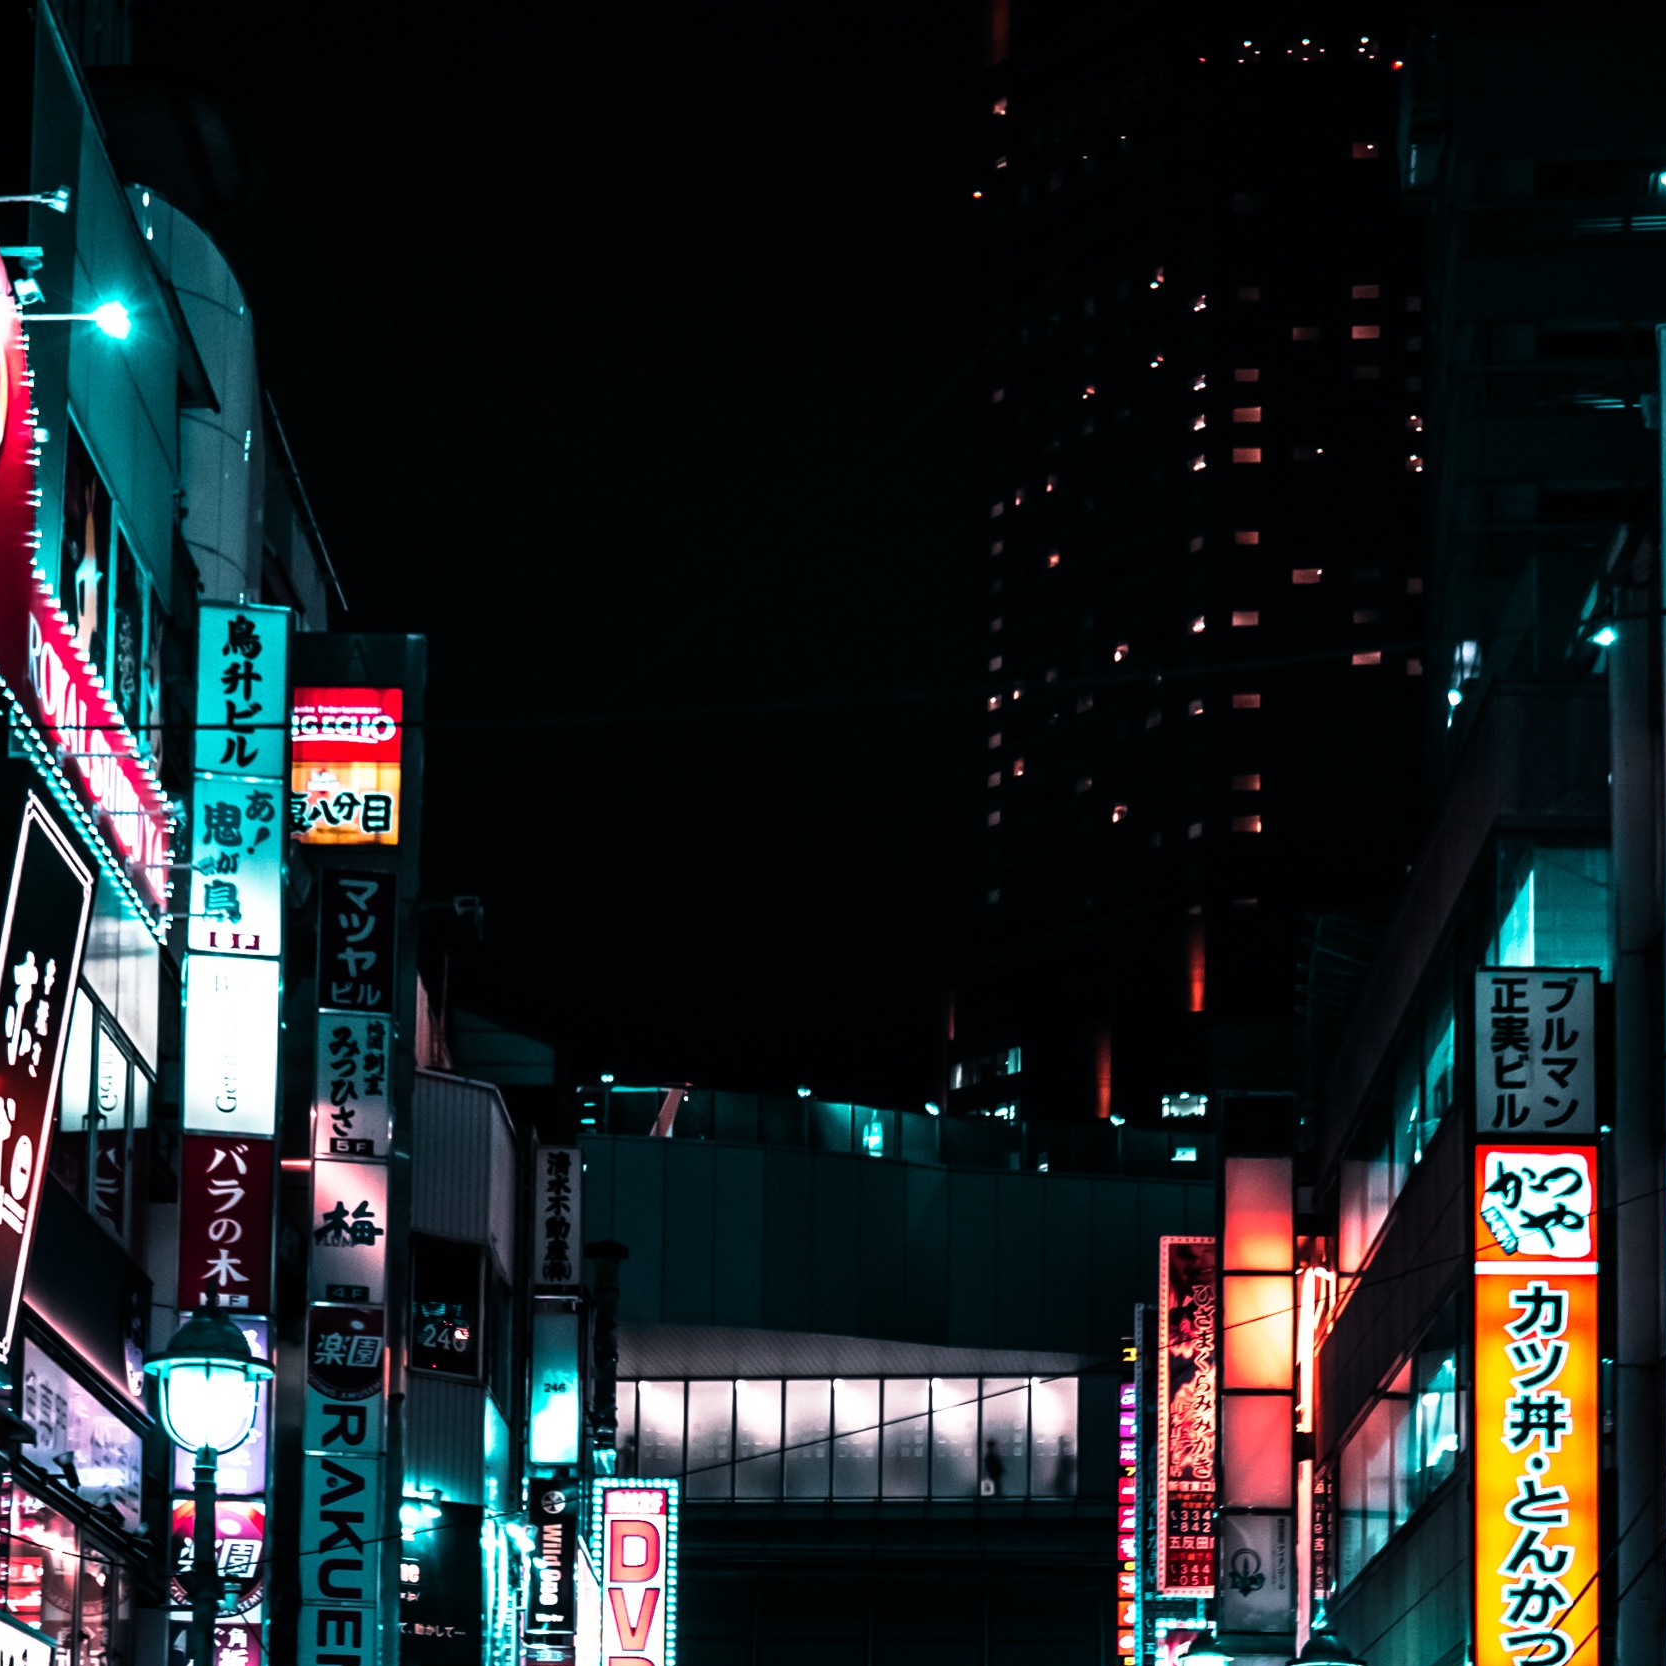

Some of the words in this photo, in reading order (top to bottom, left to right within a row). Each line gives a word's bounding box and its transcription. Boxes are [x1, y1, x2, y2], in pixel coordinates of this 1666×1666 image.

[320, 714, 397, 742] ECHO
[1490, 977, 1530, 1128] 正実ビル
[335, 1138, 369, 1155] 5F
[200, 1143, 250, 1287] バラの木
[314, 1200, 384, 1248] 梅
[313, 1334, 384, 1368] 楽園
